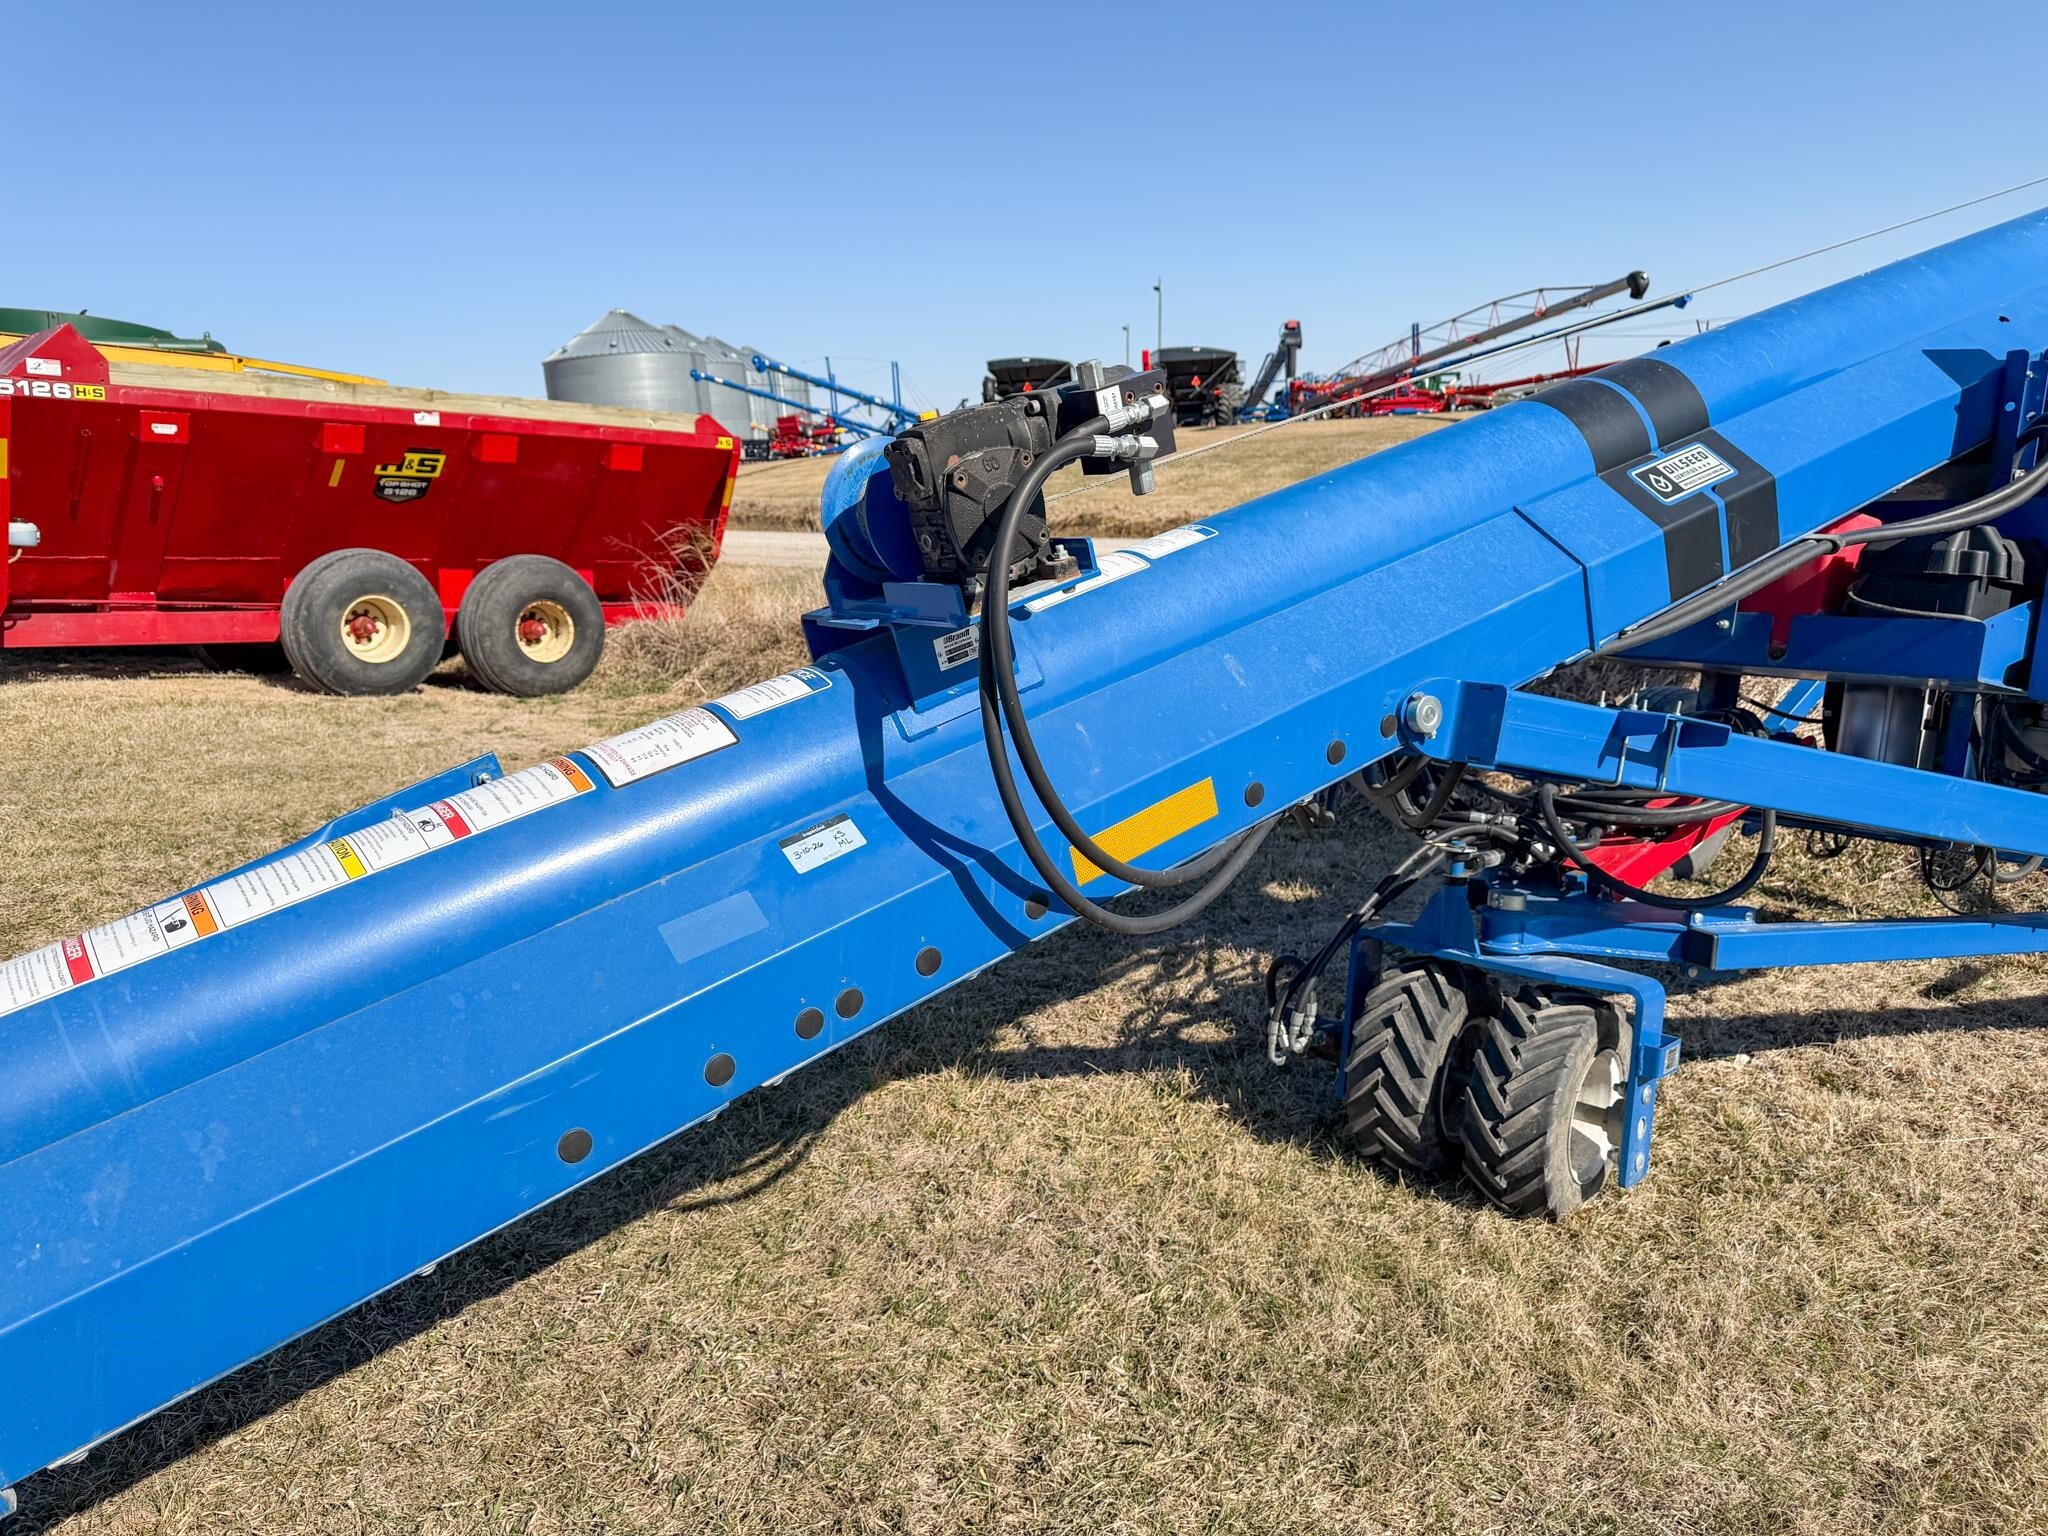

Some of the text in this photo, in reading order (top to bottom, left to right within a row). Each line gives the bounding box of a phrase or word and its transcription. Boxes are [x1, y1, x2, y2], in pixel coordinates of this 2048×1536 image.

[75, 387, 104, 398] H&S
[982, 456, 1000, 471] 60
[1662, 450, 1708, 474] OILSEED
[1672, 466, 1699, 480] CERTIFIED
[383, 488, 417, 496] 5126
[948, 628, 970, 643] Brandt
[838, 838, 854, 847] ML
[793, 841, 824, 860] 3-10-26
[146, 923, 160, 941] HAZARD
